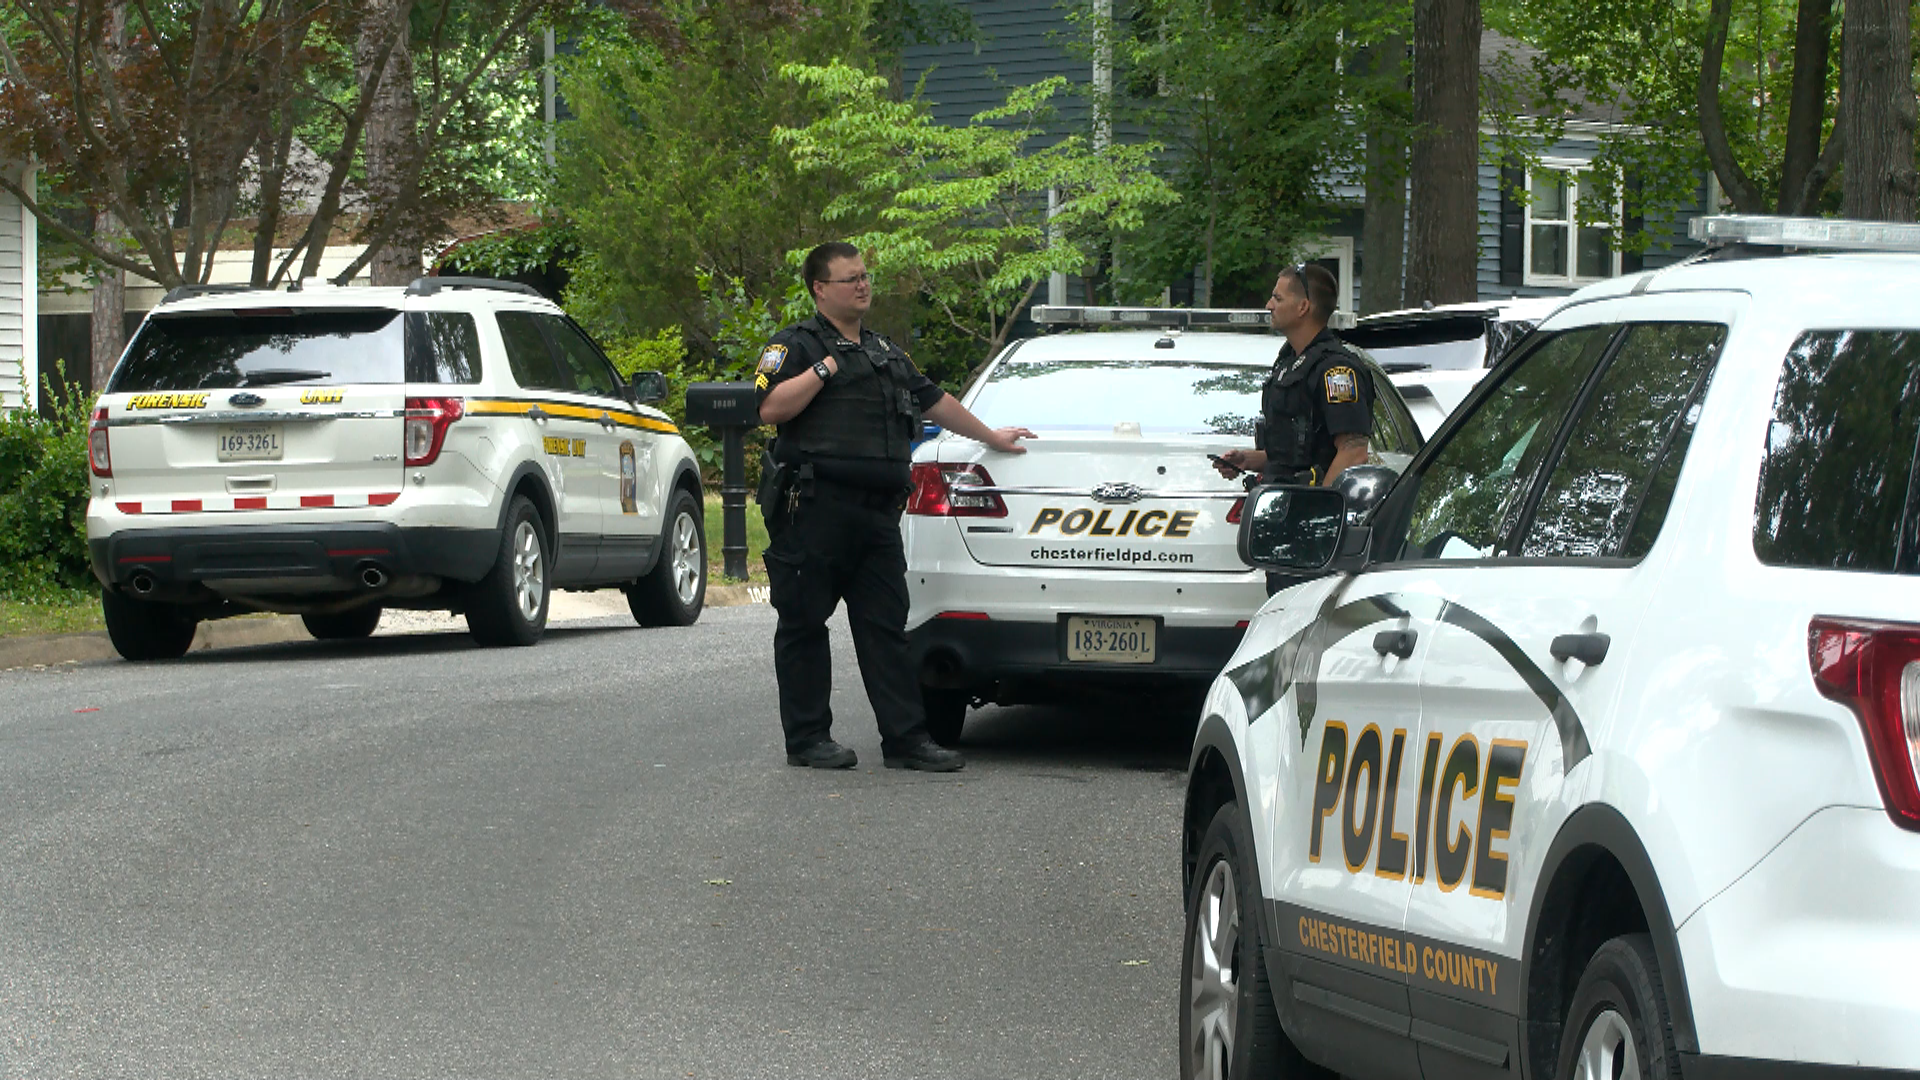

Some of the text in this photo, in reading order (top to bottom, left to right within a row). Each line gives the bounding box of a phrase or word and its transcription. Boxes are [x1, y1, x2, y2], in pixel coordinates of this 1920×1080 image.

[126, 388, 347, 410] FORENSIC UNIT
[221, 434, 279, 451] 169-326L
[542, 435, 587, 459] FORENSIC UNIT
[1028, 508, 1200, 538] POLICE
[1030, 547, 1194, 564] chesterfieldpd.com
[1091, 620, 1133, 629] VIRGINIA
[1075, 630, 1150, 653] 183-260L
[1309, 720, 1528, 901] POLICE
[1298, 916, 1498, 995] CHESTERFIELD COUNTY
